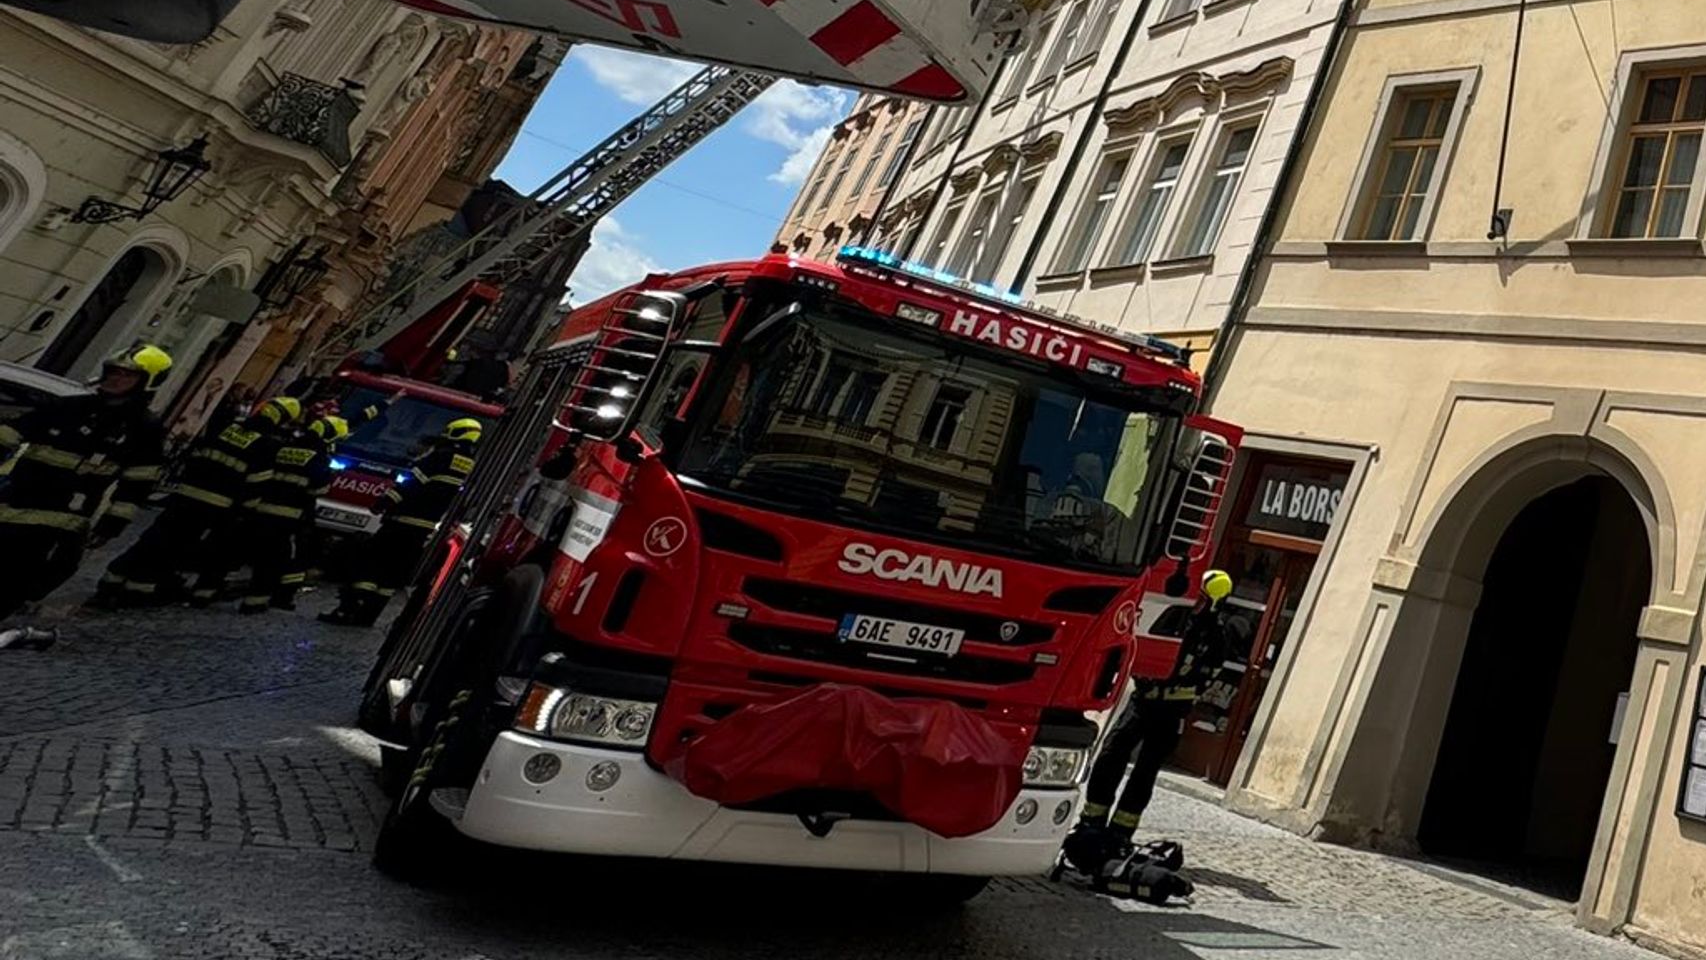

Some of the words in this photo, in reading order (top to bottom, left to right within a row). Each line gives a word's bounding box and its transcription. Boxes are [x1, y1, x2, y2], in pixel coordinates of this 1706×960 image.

[950, 310, 1082, 366] HASIČI
[1261, 480, 1286, 515] LA
[837, 542, 1003, 599] SCANIA
[572, 571, 599, 615] 1
[855, 619, 895, 643] 6AE
[905, 626, 954, 651] 9491
